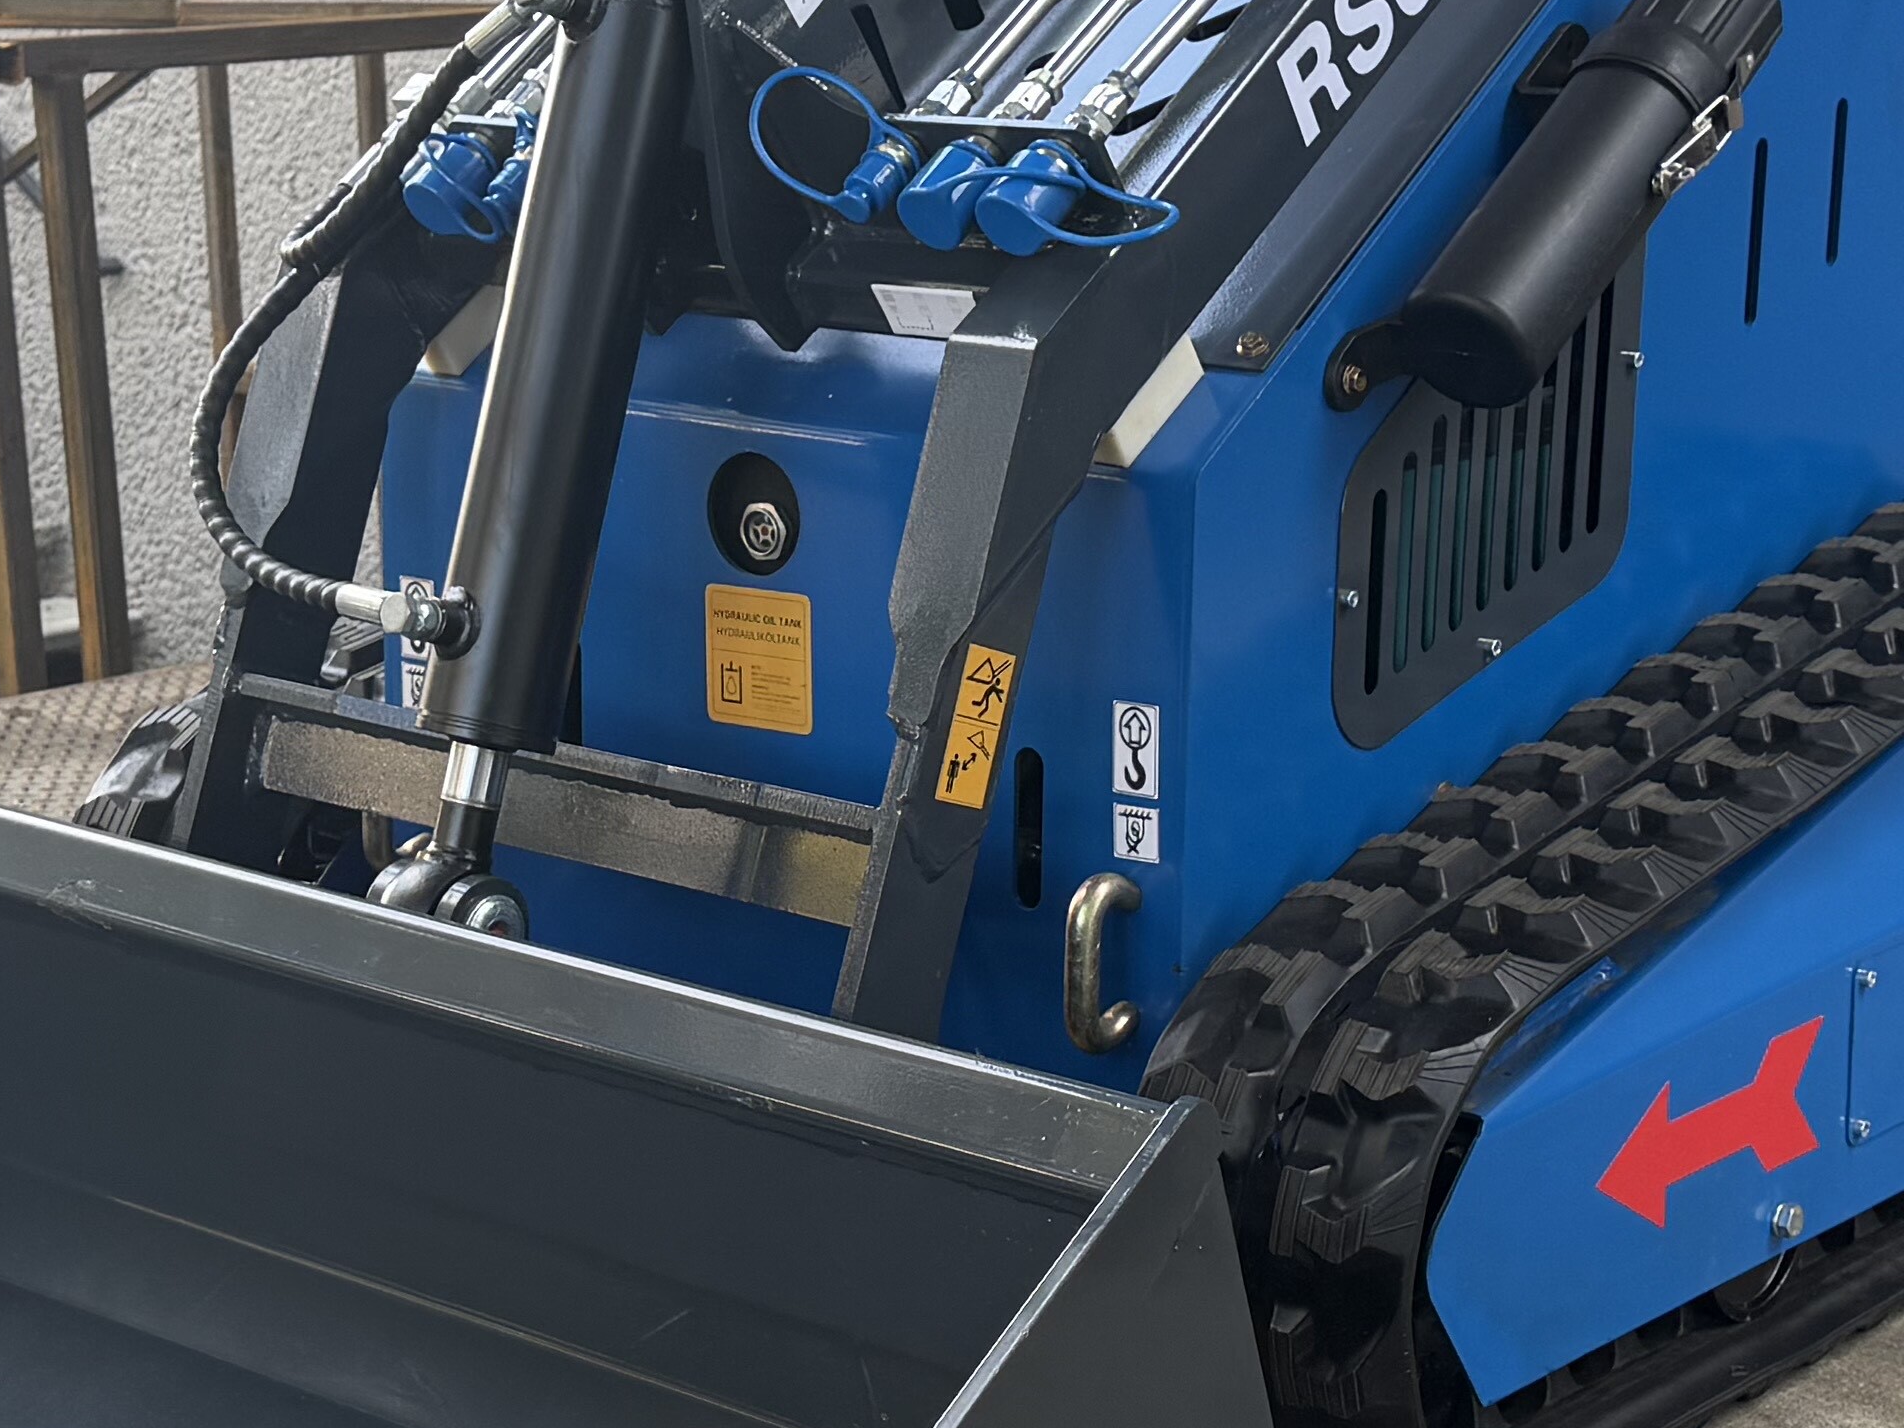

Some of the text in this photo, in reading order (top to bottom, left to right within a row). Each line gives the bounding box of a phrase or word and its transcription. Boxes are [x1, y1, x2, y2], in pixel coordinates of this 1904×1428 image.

[713, 610, 801, 628] HYDRAULIC OIL TANK
